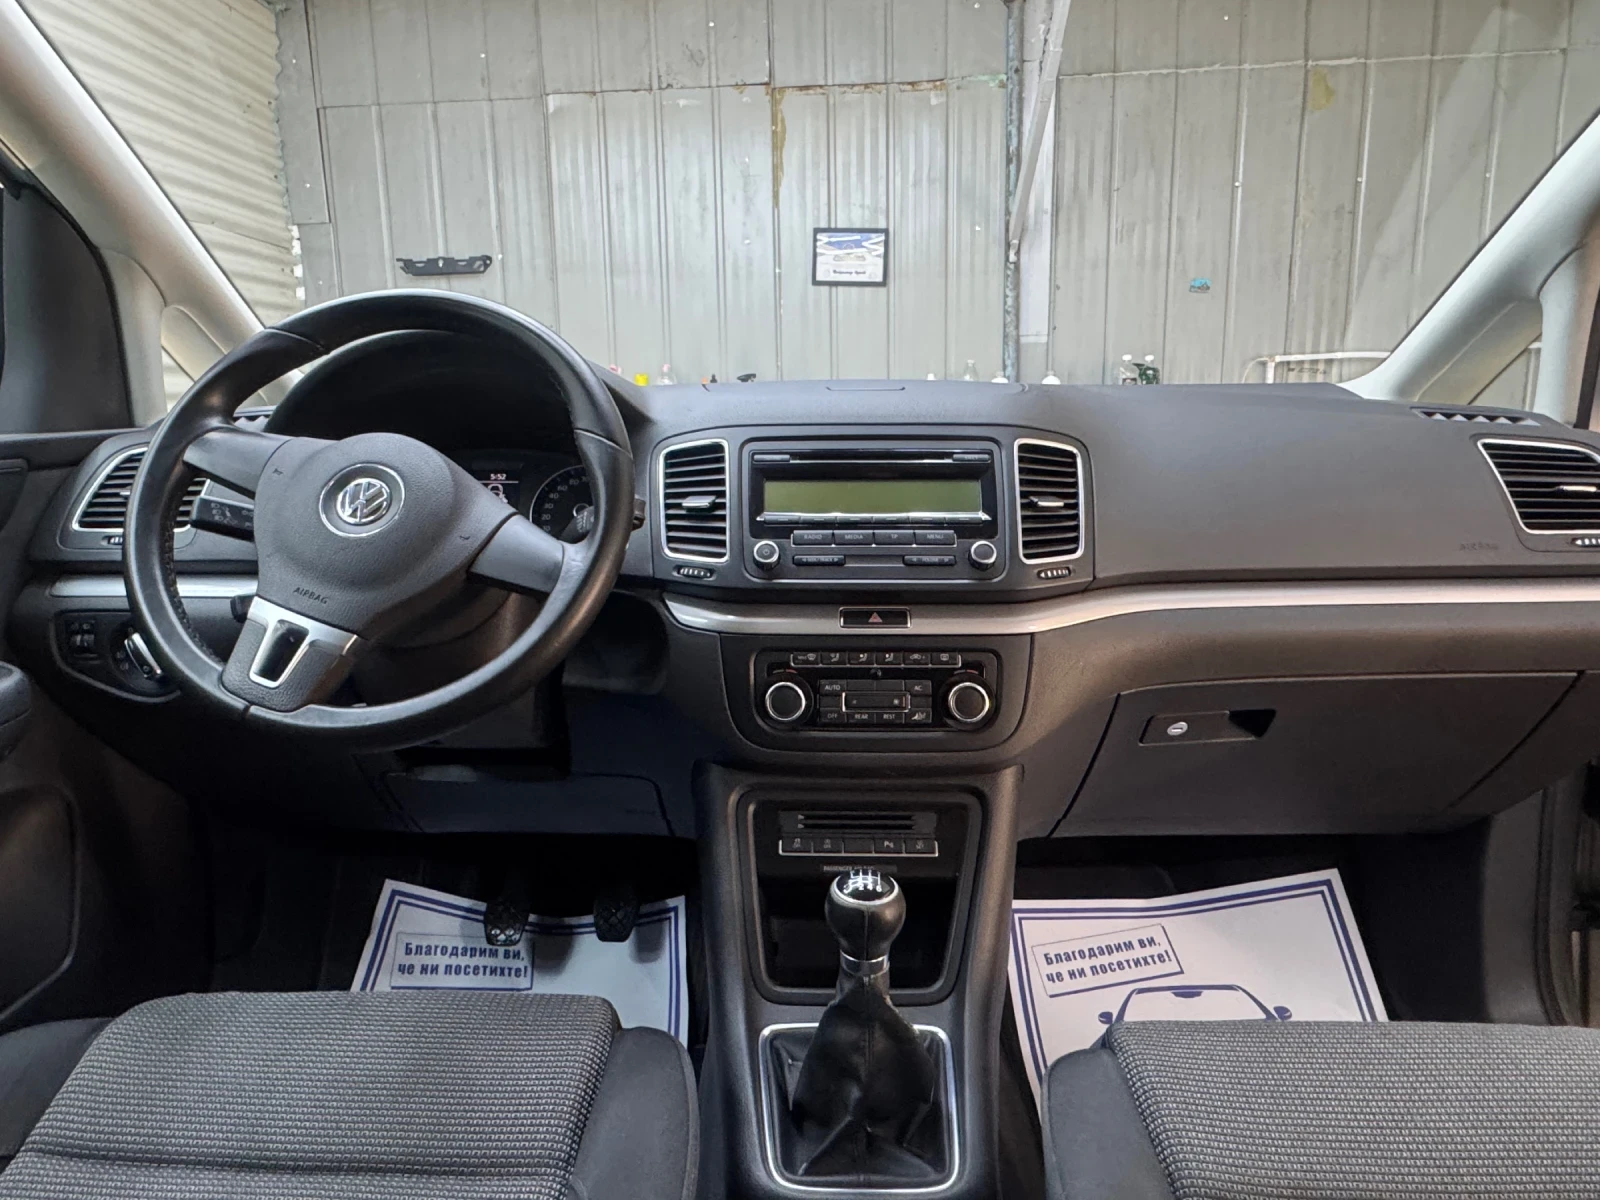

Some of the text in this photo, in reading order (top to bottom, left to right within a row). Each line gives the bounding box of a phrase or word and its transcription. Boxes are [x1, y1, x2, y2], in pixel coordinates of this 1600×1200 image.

[293, 587, 328, 605] AIRBAG
[404, 942, 525, 961] Благодарим ви,
[1043, 936, 1161, 966] Благодарим ви,
[398, 963, 528, 978] че ни посетихте!
[1046, 950, 1173, 984] че ни посетихте!
